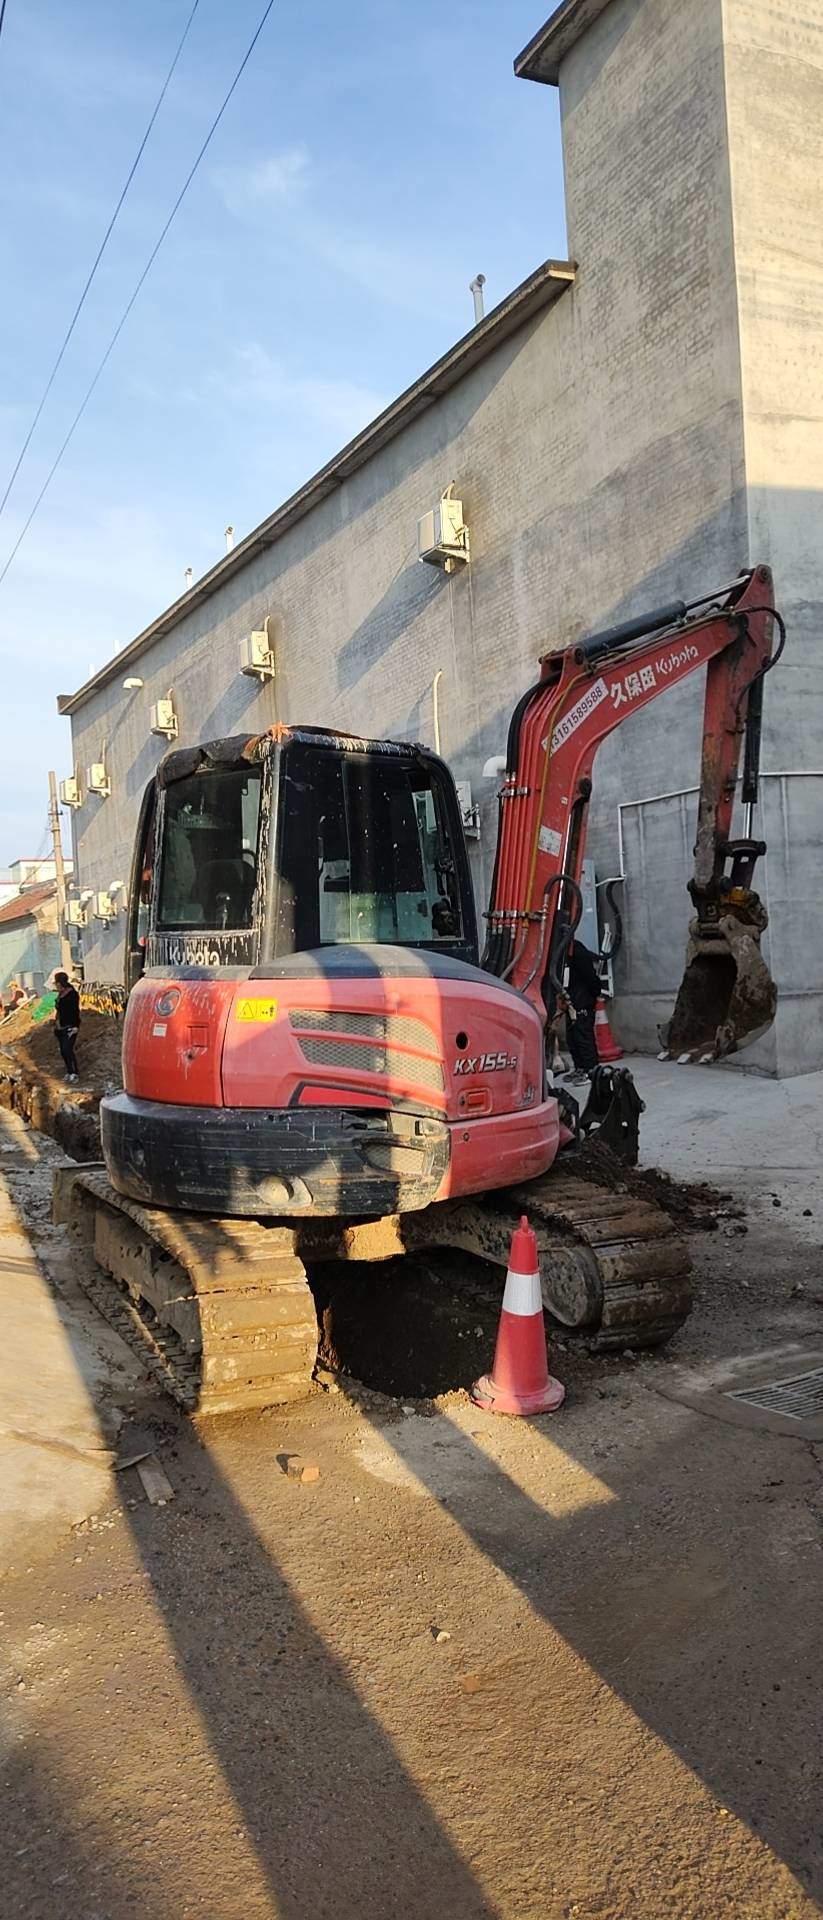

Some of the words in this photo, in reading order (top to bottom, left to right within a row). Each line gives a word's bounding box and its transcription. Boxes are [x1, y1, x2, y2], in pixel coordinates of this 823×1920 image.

[610, 664, 656, 709] 久保田
[655, 644, 699, 674] Kubota
[169, 945, 220, 966] Kubota
